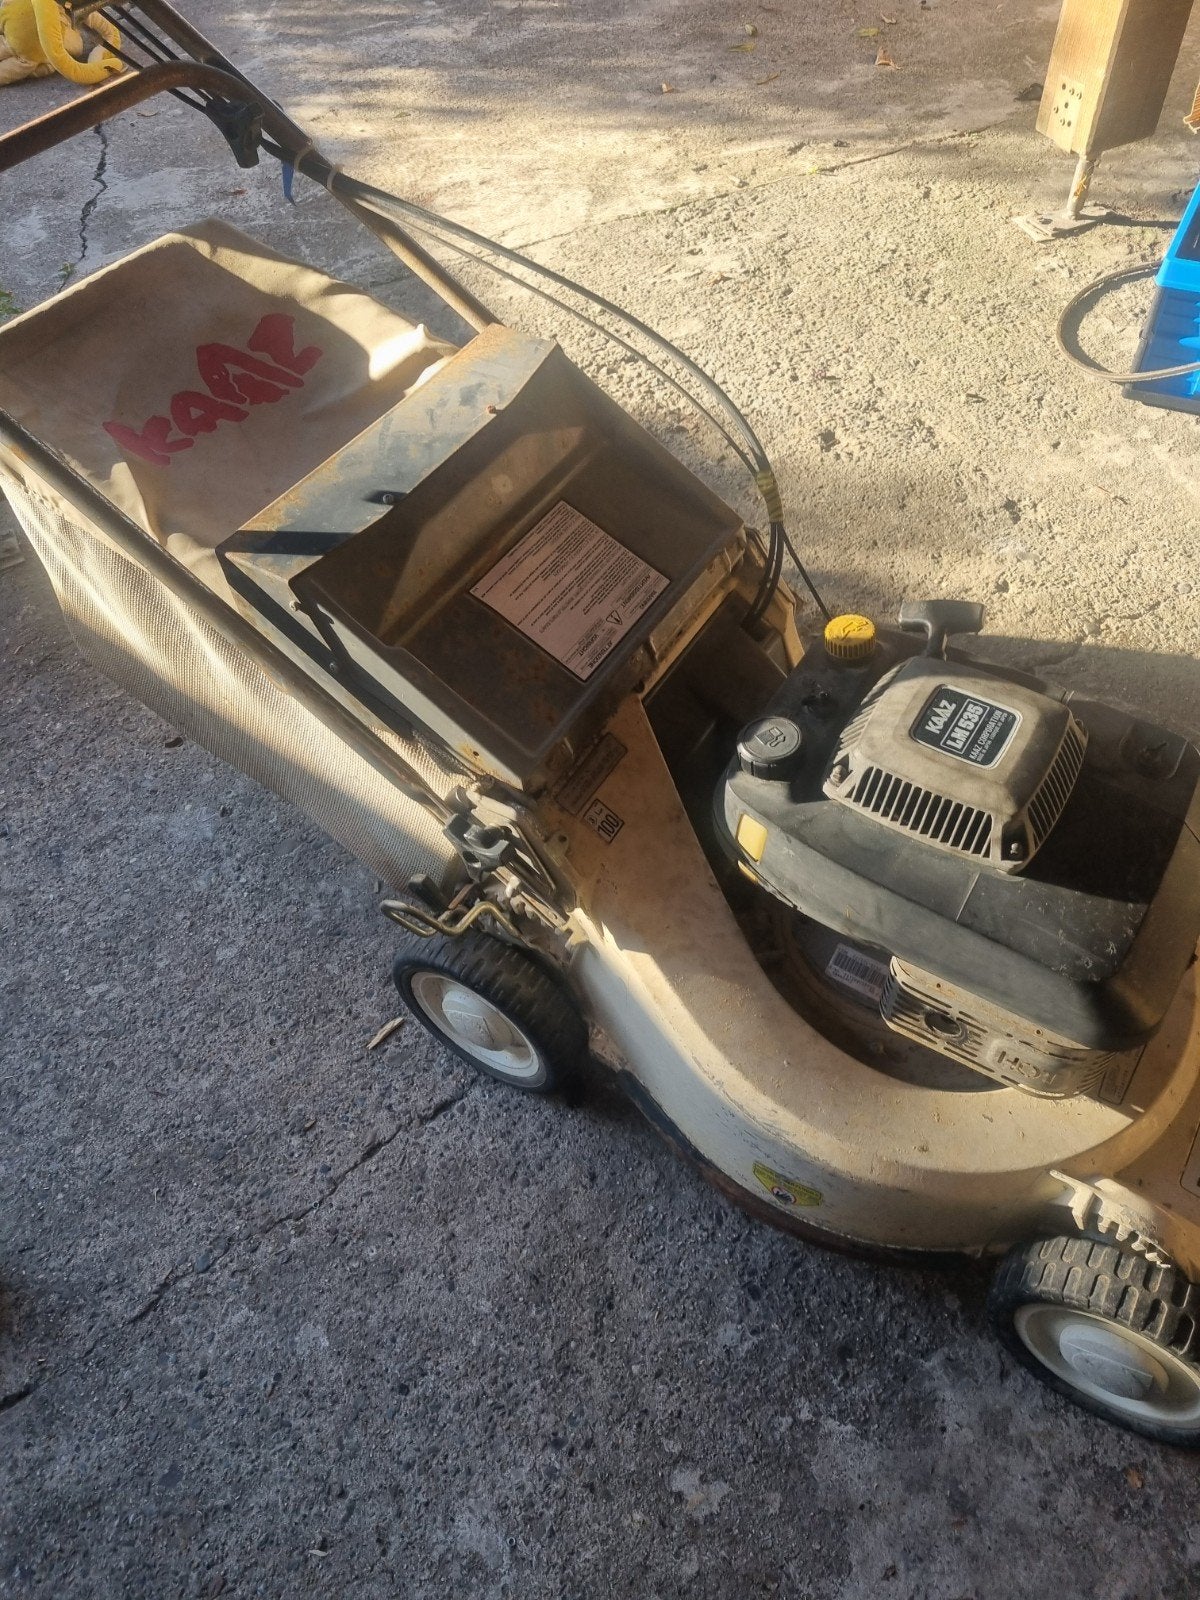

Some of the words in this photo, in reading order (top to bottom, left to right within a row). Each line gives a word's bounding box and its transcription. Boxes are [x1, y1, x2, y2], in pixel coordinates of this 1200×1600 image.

[925, 699, 957, 734] KAAZ
[946, 726, 970, 750] LM
[959, 703, 984, 731] 535
[969, 744, 983, 760] KAAZ
[977, 709, 1003, 746] CORPORATION
[597, 814, 620, 838] 100
